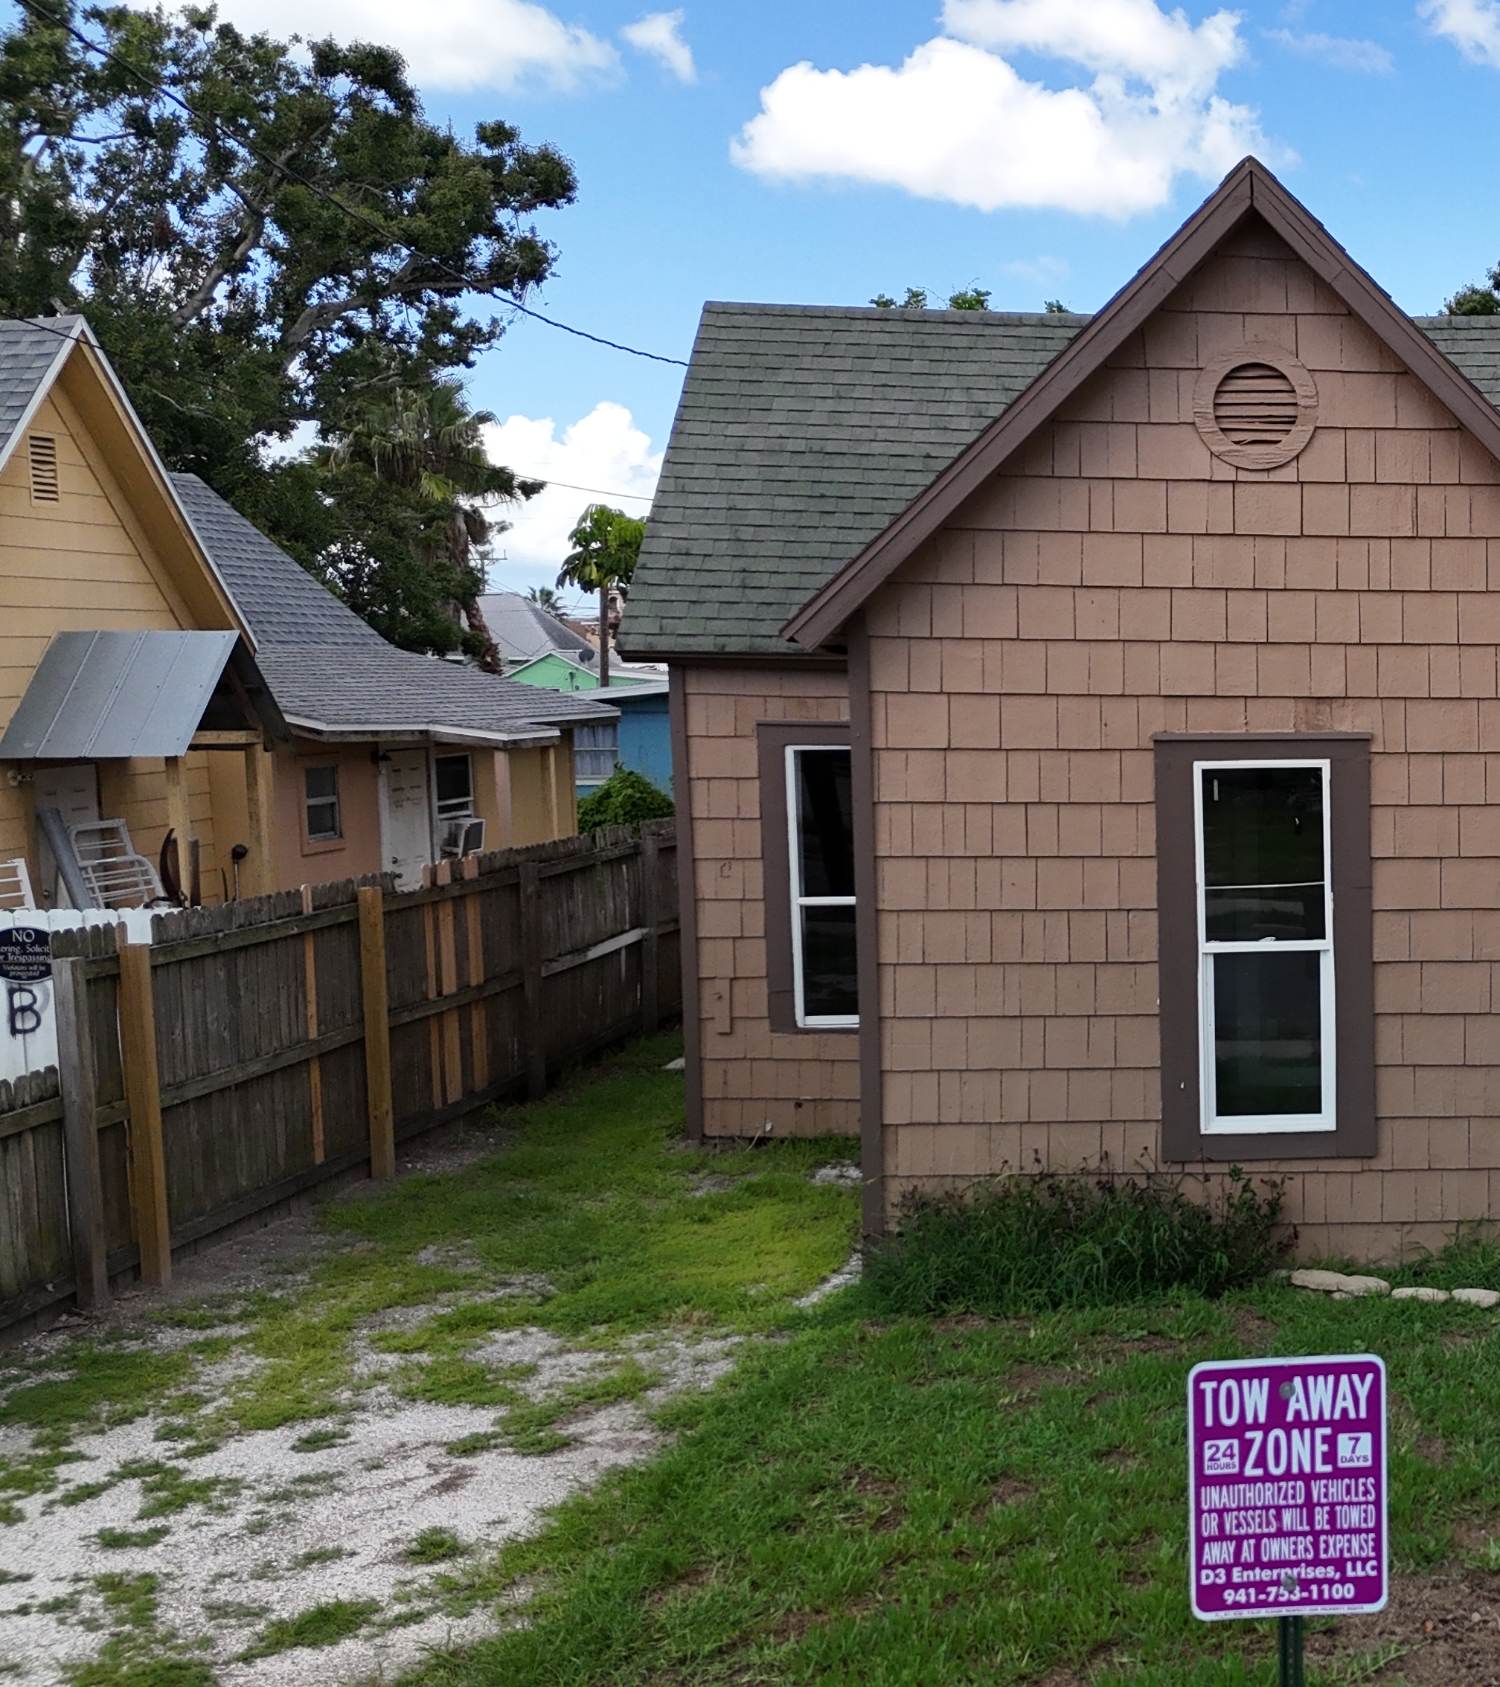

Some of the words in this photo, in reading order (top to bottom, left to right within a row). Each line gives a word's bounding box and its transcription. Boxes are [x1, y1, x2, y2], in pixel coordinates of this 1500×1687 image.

[12, 929, 35, 943] NO
[9, 986, 42, 1040] B
[1200, 1377, 1270, 1427] TOW
[1285, 1373, 1375, 1422] AWAY
[1207, 1442, 1236, 1462] 24
[1243, 1427, 1333, 1477] ZONE
[1347, 1436, 1362, 1455] 7
[1207, 1461, 1237, 1471] HOURS
[1340, 1454, 1369, 1464] DAYS
[1201, 1480, 1305, 1511] UNAUTHORIZED
[1311, 1476, 1375, 1504] VEHICLES
[1202, 1512, 1219, 1538] OR
[1223, 1508, 1277, 1536] VESSELS
[1282, 1507, 1310, 1532] WILL
[1314, 1505, 1331, 1531] BE
[1334, 1504, 1376, 1530] TOWED
[1202, 1540, 1236, 1566] AWAY
[1240, 1538, 1256, 1563] AT
[1262, 1535, 1314, 1562] OWNERS
[1319, 1533, 1376, 1559] EXPENSE
[1200, 1568, 1226, 1585] D3
[1346, 1560, 1378, 1578] LLC
[1223, 1583, 1355, 1605] 941-753-1100
